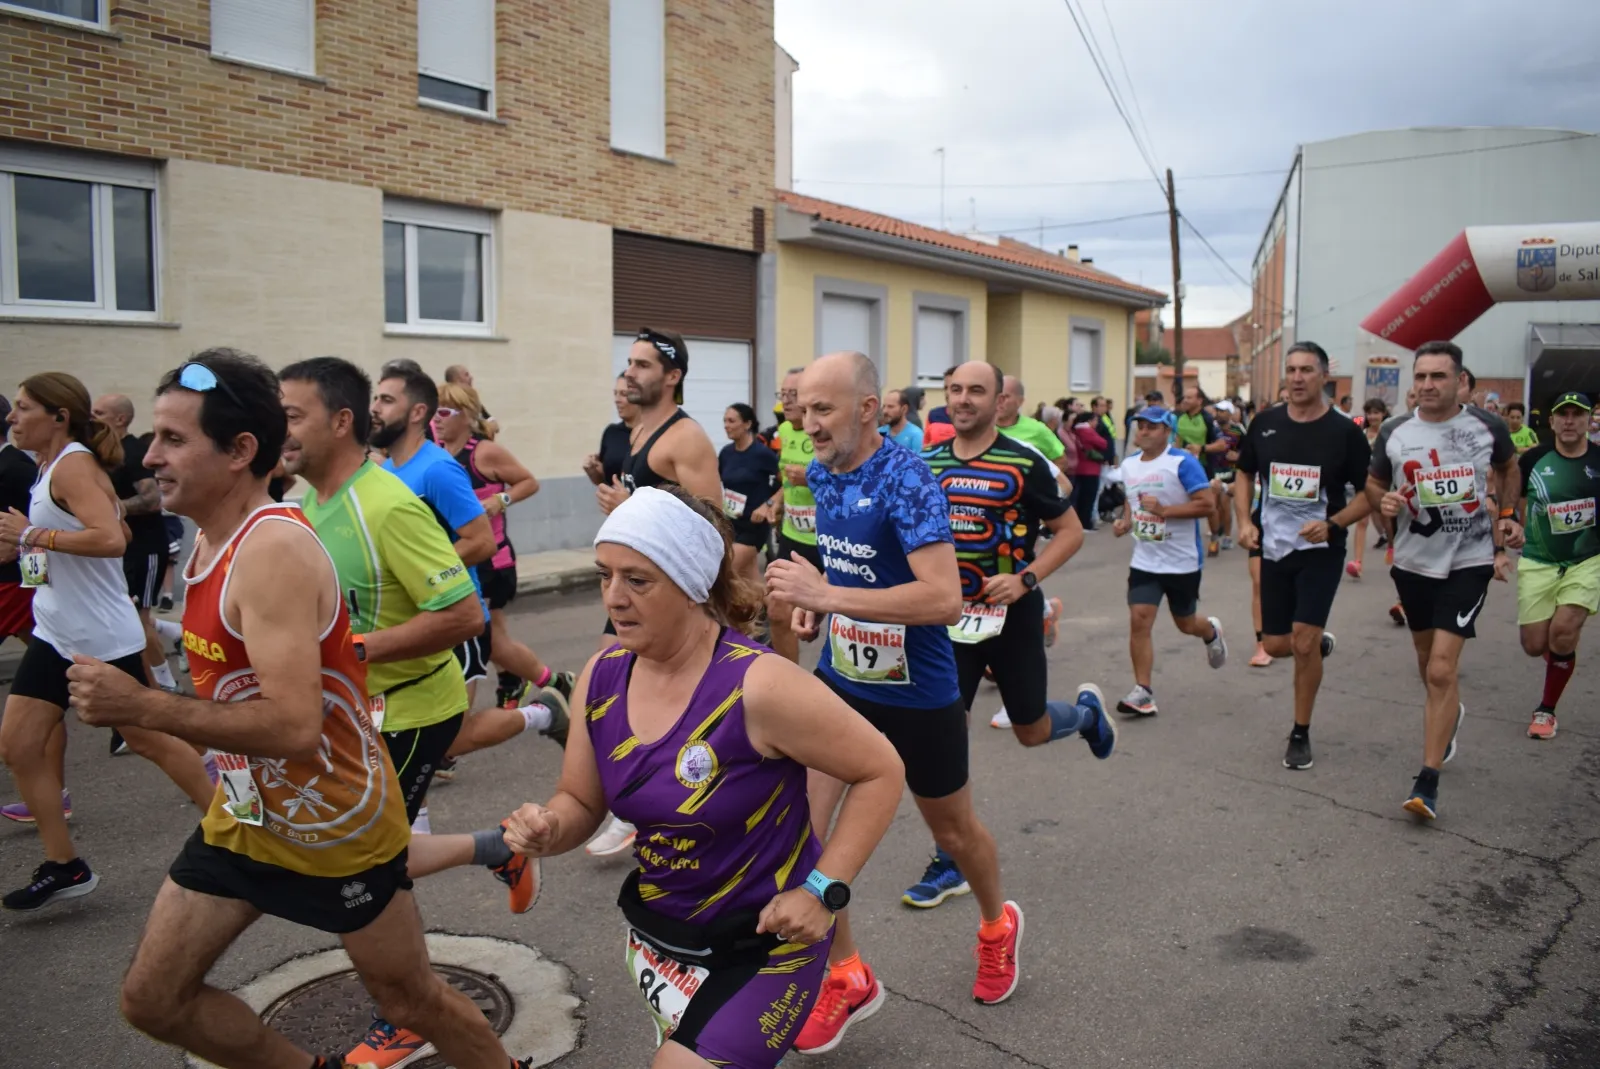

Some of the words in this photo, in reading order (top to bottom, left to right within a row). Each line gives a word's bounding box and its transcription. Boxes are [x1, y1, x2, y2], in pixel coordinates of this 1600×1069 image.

[1560, 244, 1600, 259] Diput
[1559, 272, 1571, 282] de
[1578, 267, 1598, 281] Sal
[1381, 315, 1404, 338] CON
[1404, 303, 1421, 318] EL
[1420, 259, 1471, 305] DEPORTE
[1416, 466, 1474, 482] bedunia
[949, 476, 990, 491] XXXVIII
[1284, 477, 1304, 491] 49
[1435, 480, 1458, 496] 50
[1549, 501, 1595, 515] bedunia
[1564, 511, 1582, 525] 62
[1140, 523, 1156, 535] 23
[818, 533, 877, 559] apaches
[822, 554, 877, 583] running
[961, 615, 983, 632] 71
[831, 616, 904, 648] bedunia
[848, 643, 878, 669] 19
[639, 968, 668, 1014] 86
[757, 982, 798, 1035] Atletismo
[766, 990, 810, 1050] Macotera
